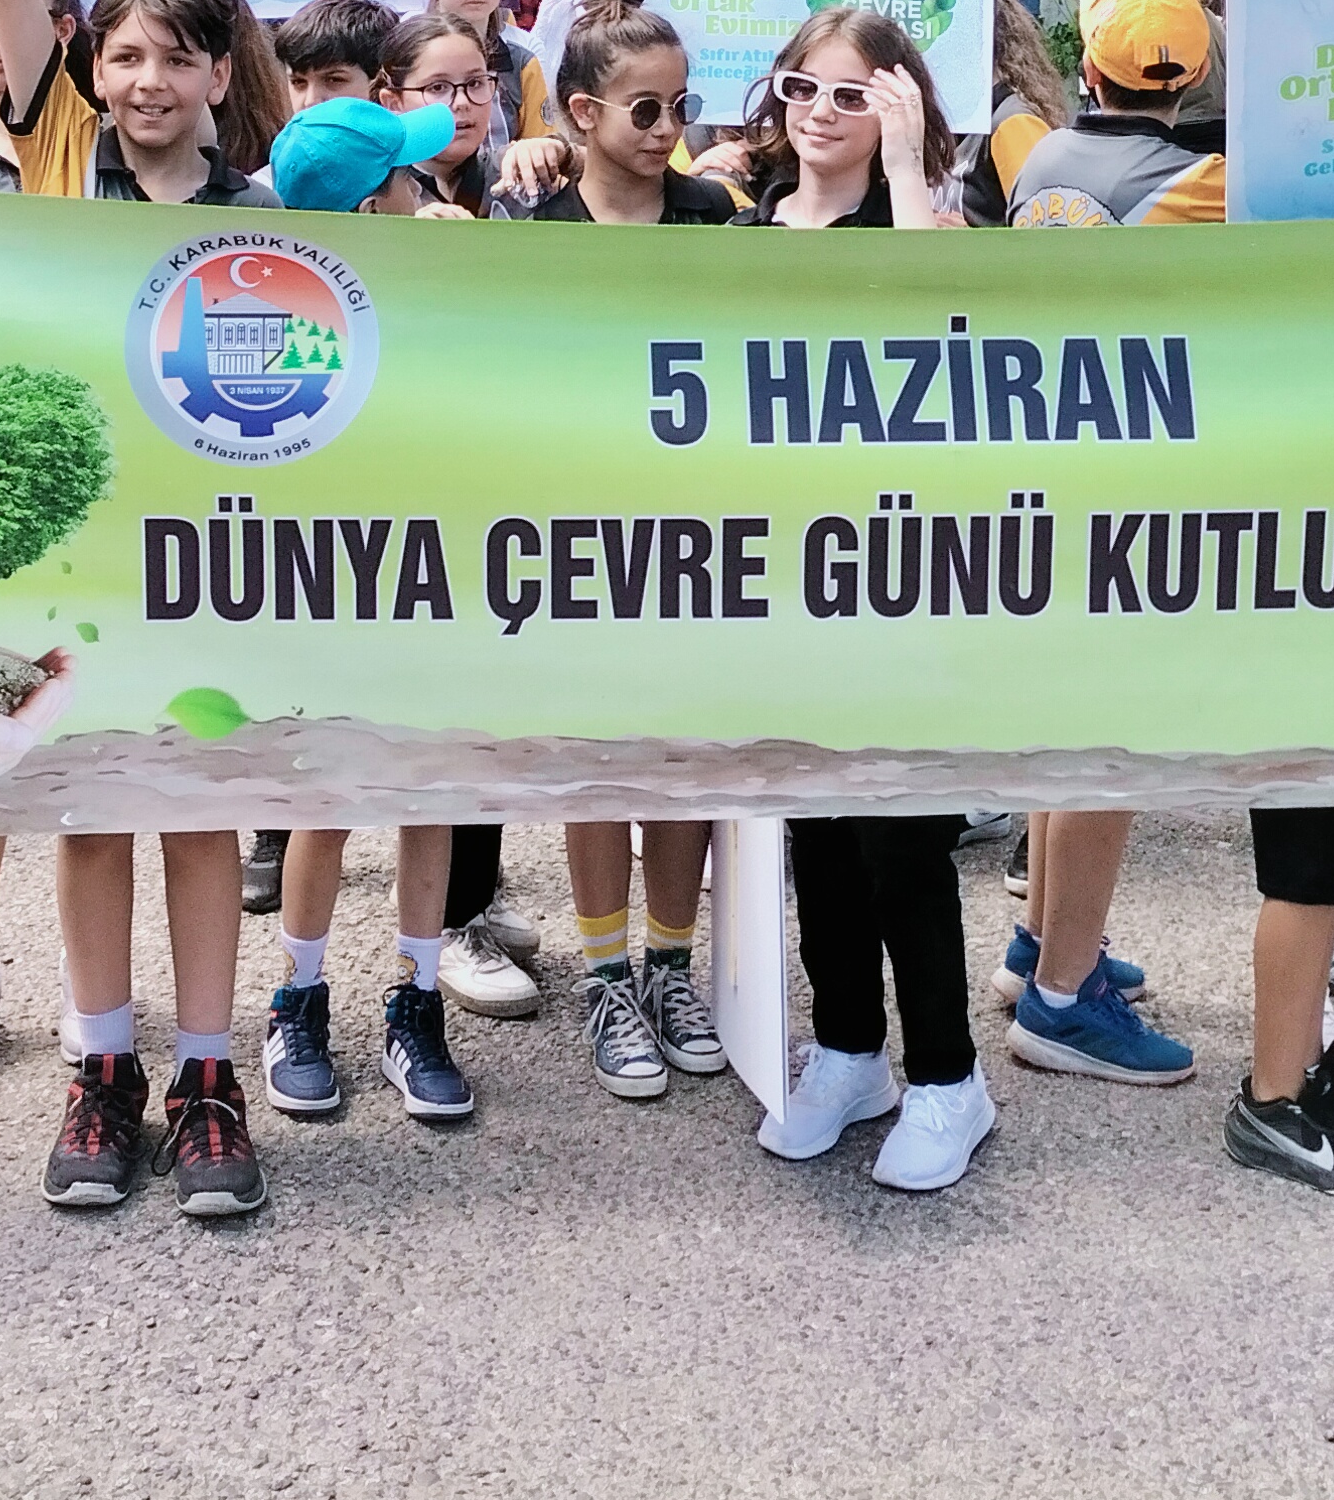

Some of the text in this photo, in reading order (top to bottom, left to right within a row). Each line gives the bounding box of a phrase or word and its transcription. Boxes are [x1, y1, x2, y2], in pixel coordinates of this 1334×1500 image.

[699, 47, 740, 61] Sıfır
[138, 232, 371, 313] T.C. KARABÜK VALİLİĞİ
[229, 387, 236, 395] 3
[651, 316, 1195, 445] 5 HAZİRAN
[194, 437, 312, 462] 6 Haziran 1995
[145, 496, 454, 621] DÜNYA
[486, 517, 769, 636] ÇEVRE
[804, 492, 1054, 617] GÜNÜ
